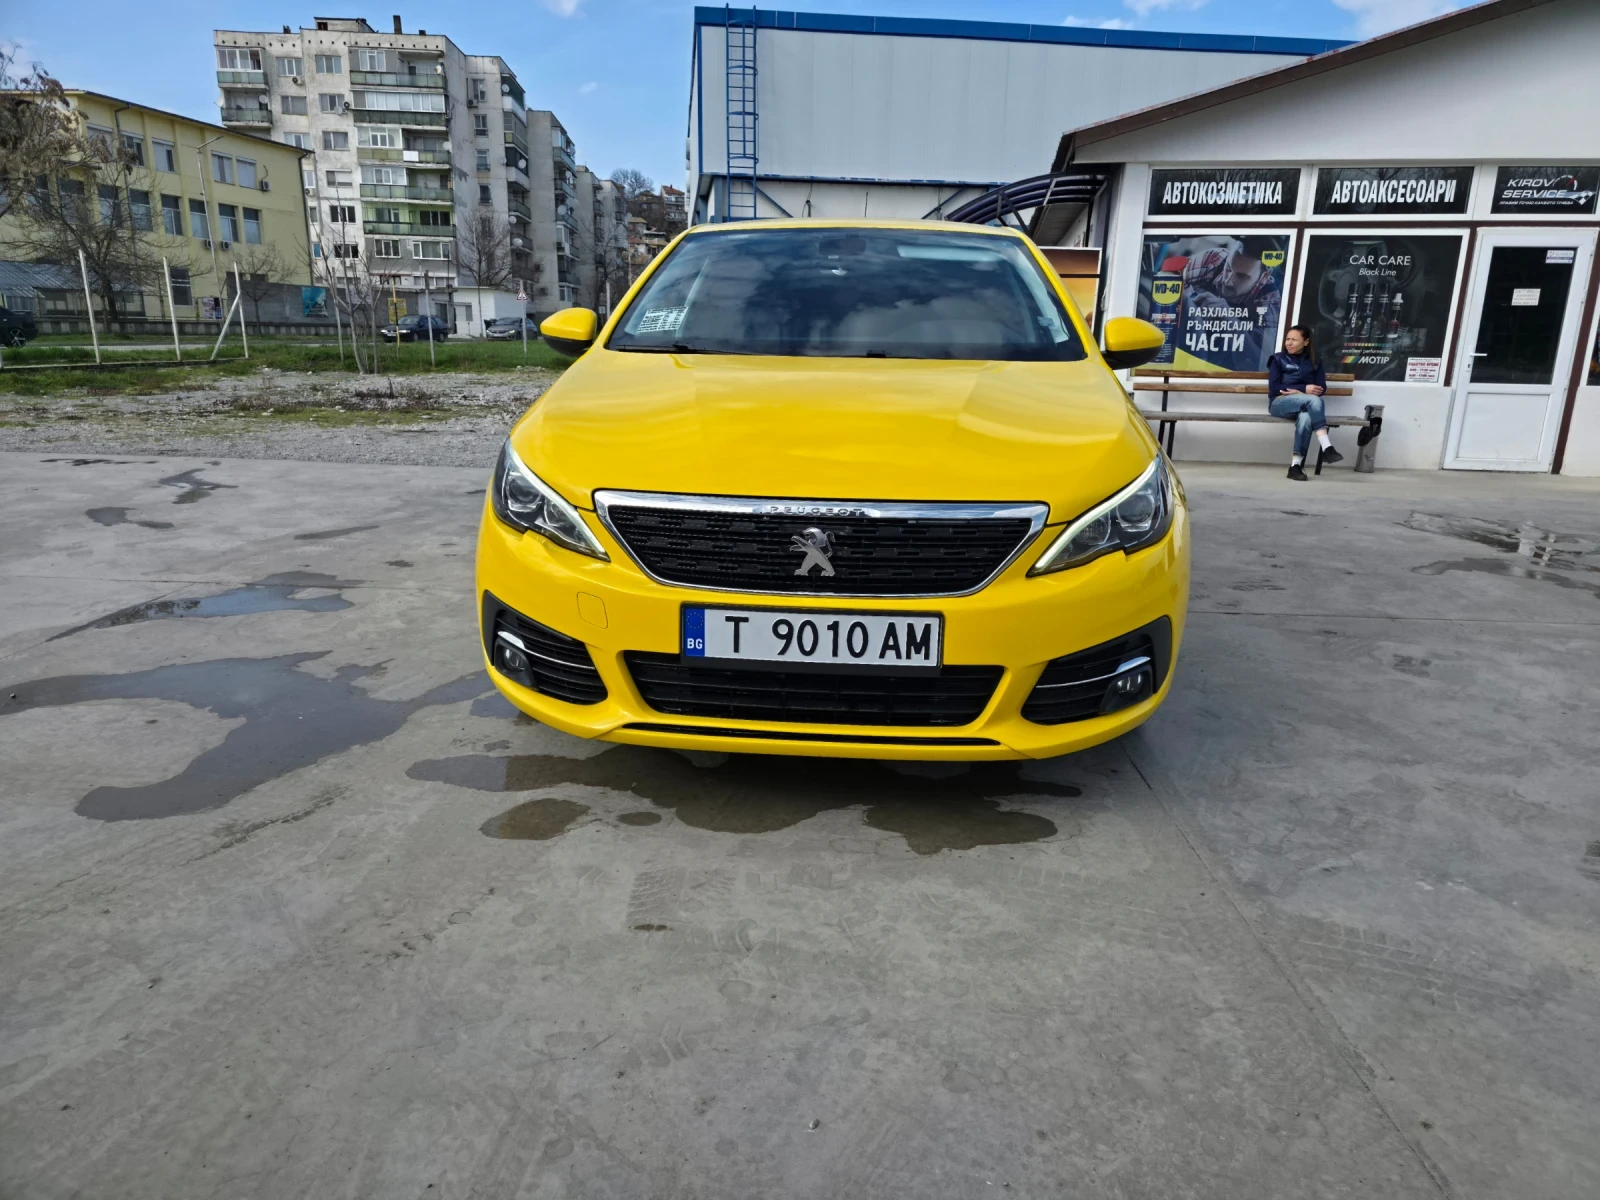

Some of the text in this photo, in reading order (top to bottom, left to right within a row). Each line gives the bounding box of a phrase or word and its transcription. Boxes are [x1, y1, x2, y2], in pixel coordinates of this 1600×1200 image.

[1507, 178, 1556, 187] KIROV
[1162, 181, 1282, 205] АВТОКОЗМЕТИКА
[1331, 179, 1457, 203] АВТОАКСЕСОАРИ
[1502, 190, 1568, 198] SERVICE
[1264, 252, 1283, 260] WD-40
[1349, 255, 1412, 266] CAR CARE
[1358, 267, 1397, 276] Black Line
[1154, 283, 1181, 295] WD-40
[1188, 306, 1249, 318] РАЗХЛАБВА
[1186, 320, 1254, 333] РЪЖДЯСАЛИ
[1185, 332, 1246, 352] ЧАСТИ
[1357, 355, 1390, 364] MOTIP
[770, 506, 863, 517] PEUGEOT
[687, 637, 703, 650] BG
[724, 615, 932, 661] T 9010 AM
